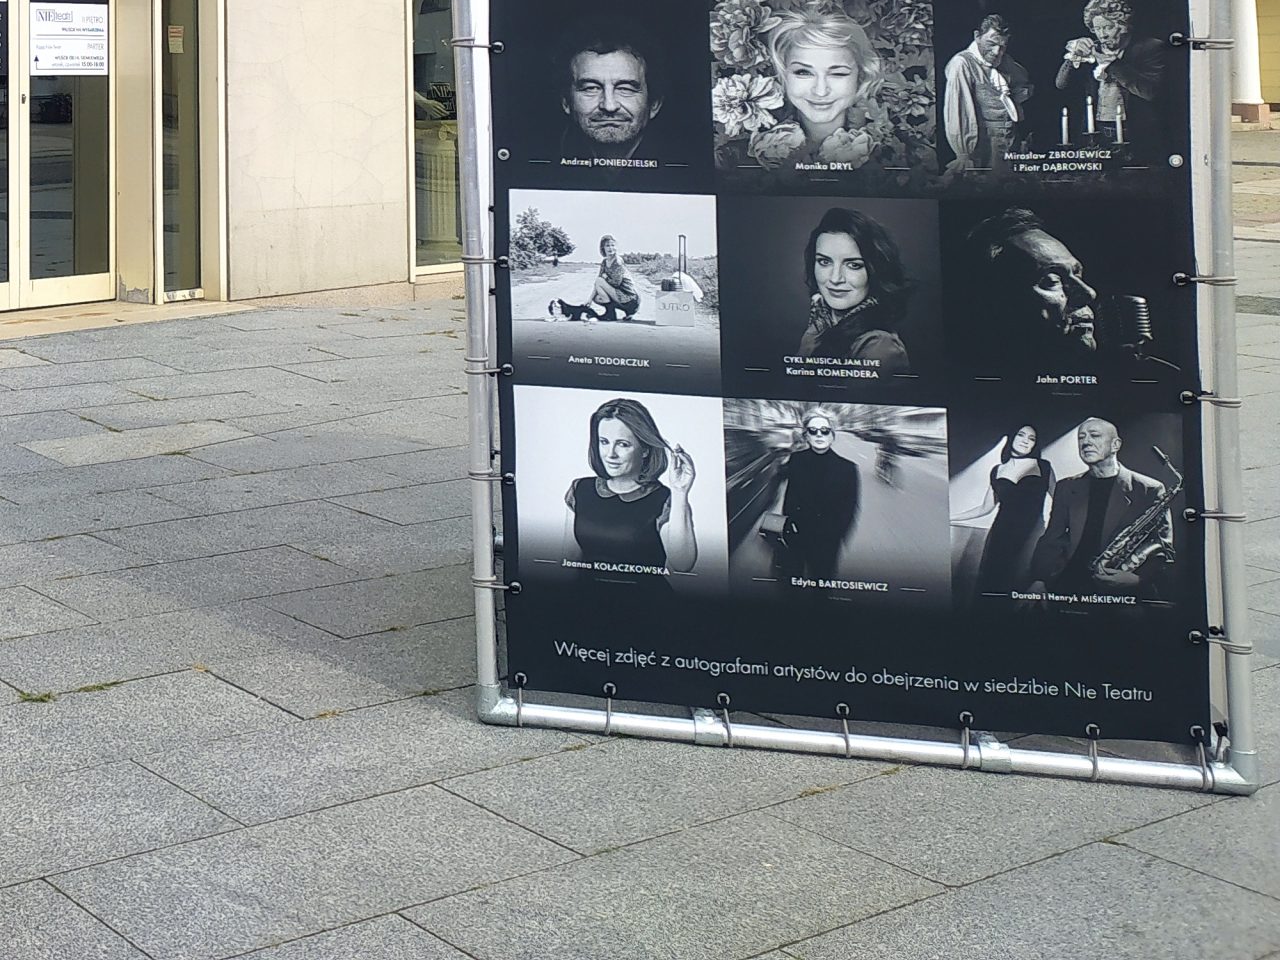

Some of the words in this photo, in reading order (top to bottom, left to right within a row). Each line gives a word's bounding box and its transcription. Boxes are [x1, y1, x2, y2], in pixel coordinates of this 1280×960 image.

[1004, 151, 1046, 160] Mirosław
[1048, 150, 1112, 159] ZBROJEWICZ
[560, 157, 592, 167] Andrzej
[593, 158, 658, 168] PONIEDZIELSKI
[795, 161, 828, 170] Monika
[829, 162, 854, 171] DRYL
[1019, 163, 1041, 172] Piotr
[1042, 163, 1102, 173] DĄBROWSKI
[568, 355, 593, 365] Aneta
[594, 356, 650, 368] TODORCZUK
[783, 356, 804, 364] CYKL
[805, 357, 842, 366] MUSICAL
[863, 359, 880, 367] LIVE
[786, 367, 815, 376] Karina
[817, 368, 879, 378] KOMENDERA
[1035, 375, 1059, 384] John
[1060, 375, 1098, 384] PORTER
[562, 558, 592, 569] Joanna
[593, 561, 670, 576] KOŁACZKOWSKA
[791, 577, 817, 588] Edyta
[818, 579, 889, 592] BARTOSIEWICZ
[1011, 591, 1041, 600] Dorota
[1048, 592, 1079, 603] Henryk
[1080, 593, 1137, 605] MIŚKIEWICZ
[554, 640, 611, 667] Więcej
[615, 648, 657, 668] zdjęć
[661, 656, 671, 667] z
[674, 656, 769, 677] autografami
[773, 664, 840, 682] artystów
[844, 666, 867, 684] do
[872, 668, 959, 691] obejrzenia
[963, 680, 979, 692] w
[984, 676, 1059, 697] siedzibie
[1064, 681, 1097, 700] Nie
[1101, 683, 1153, 702] Teatru
